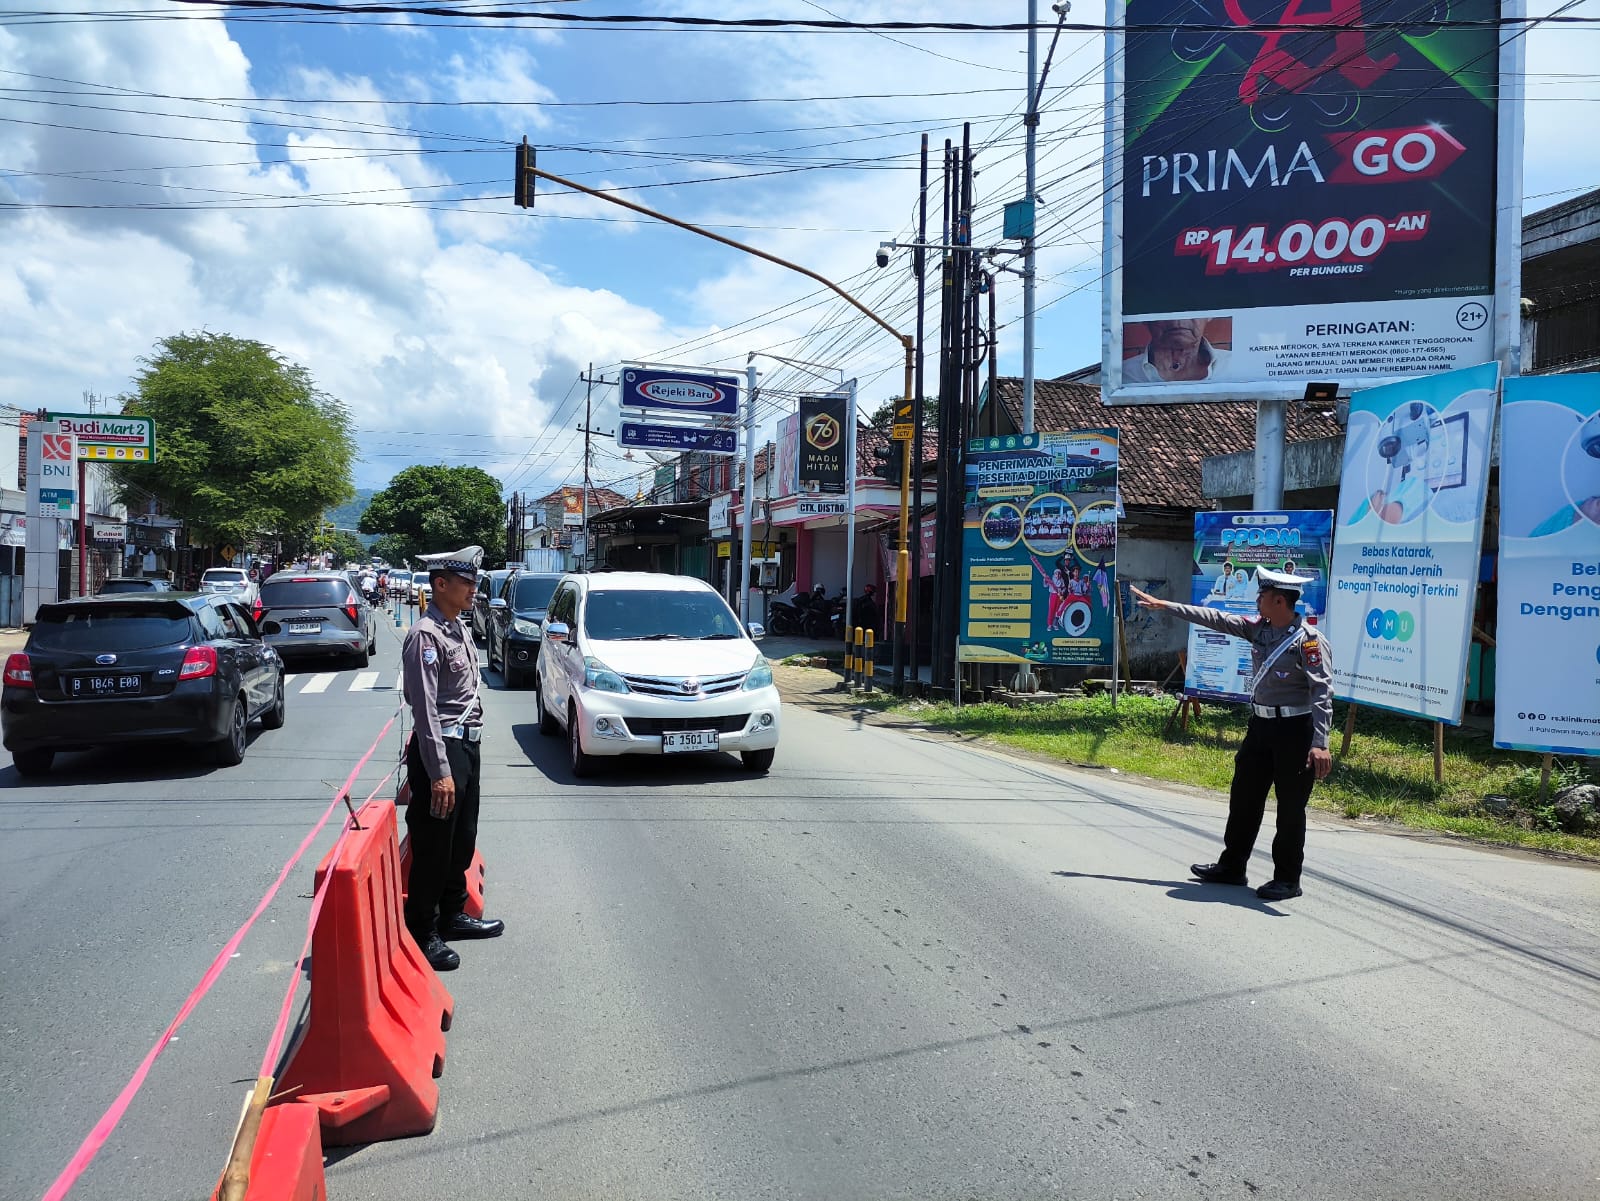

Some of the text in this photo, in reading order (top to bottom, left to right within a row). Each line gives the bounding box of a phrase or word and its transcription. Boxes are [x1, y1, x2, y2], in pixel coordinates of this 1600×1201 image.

[1142, 132, 1436, 197] PRIMA GO
[1289, 264, 1363, 277] PER BUNGKUS
[1461, 311, 1484, 323] 21+
[1305, 320, 1415, 336] PERINGATAN:
[1280, 343, 1319, 351] MEROKOK,
[1342, 340, 1377, 348] TERKENA
[1378, 339, 1411, 347] KANKER
[1265, 360, 1303, 368] DILARANG
[1304, 359, 1340, 367] MENJUAL
[1358, 357, 1394, 365] MEMBERI
[1395, 355, 1427, 363] KEPADA
[1428, 354, 1457, 362] ORANG
[1275, 352, 1310, 360] LAYANAN
[1311, 350, 1348, 358] BERHENTI
[1349, 348, 1388, 357] MEROKOK
[1277, 369, 1304, 377] BAWAH
[1379, 364, 1427, 374] PEREMPUAN
[1428, 363, 1454, 371] HAMIL
[651, 385, 713, 399] Rejeki Baru
[59, 419, 145, 435] Budi Mart 2
[813, 419, 833, 443] 76
[808, 454, 838, 462] MADU
[978, 456, 1053, 472] PENERIMAAN
[43, 464, 71, 477] BNI
[806, 463, 839, 471] HITAM
[978, 467, 1094, 483] PESERTA DIDIK BARU
[41, 491, 58, 499] ATM
[818, 503, 845, 513] DISTRO
[1221, 527, 1301, 547] PPDBM
[1361, 546, 1434, 559] Bebas Katarak,
[1352, 563, 1443, 578] Penglihatan Jernih
[1338, 579, 1459, 598] Dengan Teknologi Terkini
[1520, 602, 1600, 621] Dengan
[74, 679, 81, 690] B
[90, 678, 114, 689] 1846
[663, 735, 675, 746] AG
[680, 734, 702, 745] 1501
